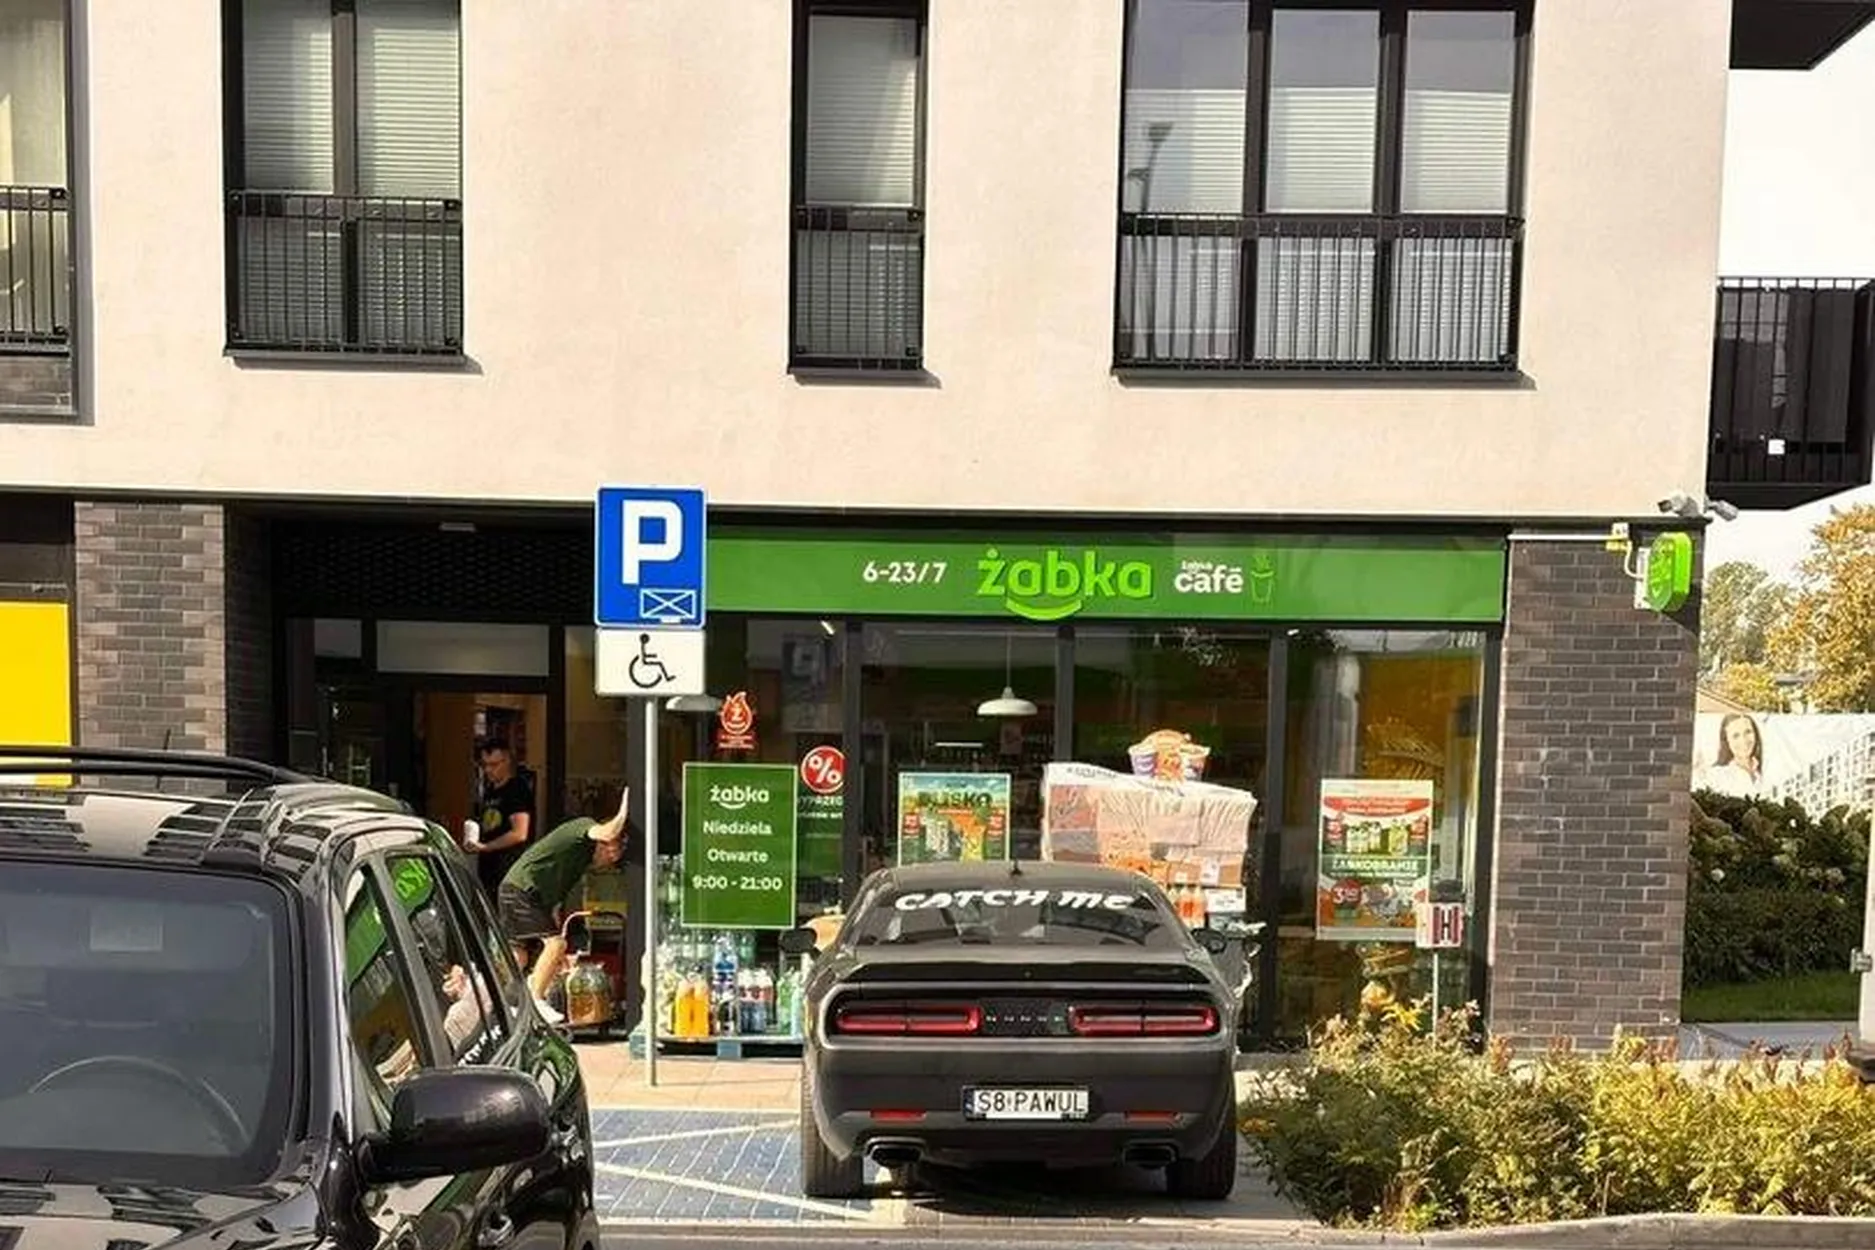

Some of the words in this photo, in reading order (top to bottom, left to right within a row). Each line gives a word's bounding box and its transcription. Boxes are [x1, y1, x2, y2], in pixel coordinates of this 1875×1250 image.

[622, 499, 683, 584] P
[863, 561, 948, 584] 6-23/7
[977, 548, 1153, 606] żabka
[710, 784, 769, 804] żabka
[703, 821, 772, 836] Niedziela
[707, 849, 768, 864] Otwarte
[692, 876, 728, 889] 9:00
[740, 876, 783, 891] 21:00
[895, 890, 1049, 910] CATCH
[979, 1091, 1005, 1112] S8
[1014, 1091, 1086, 1112] PAWUL
